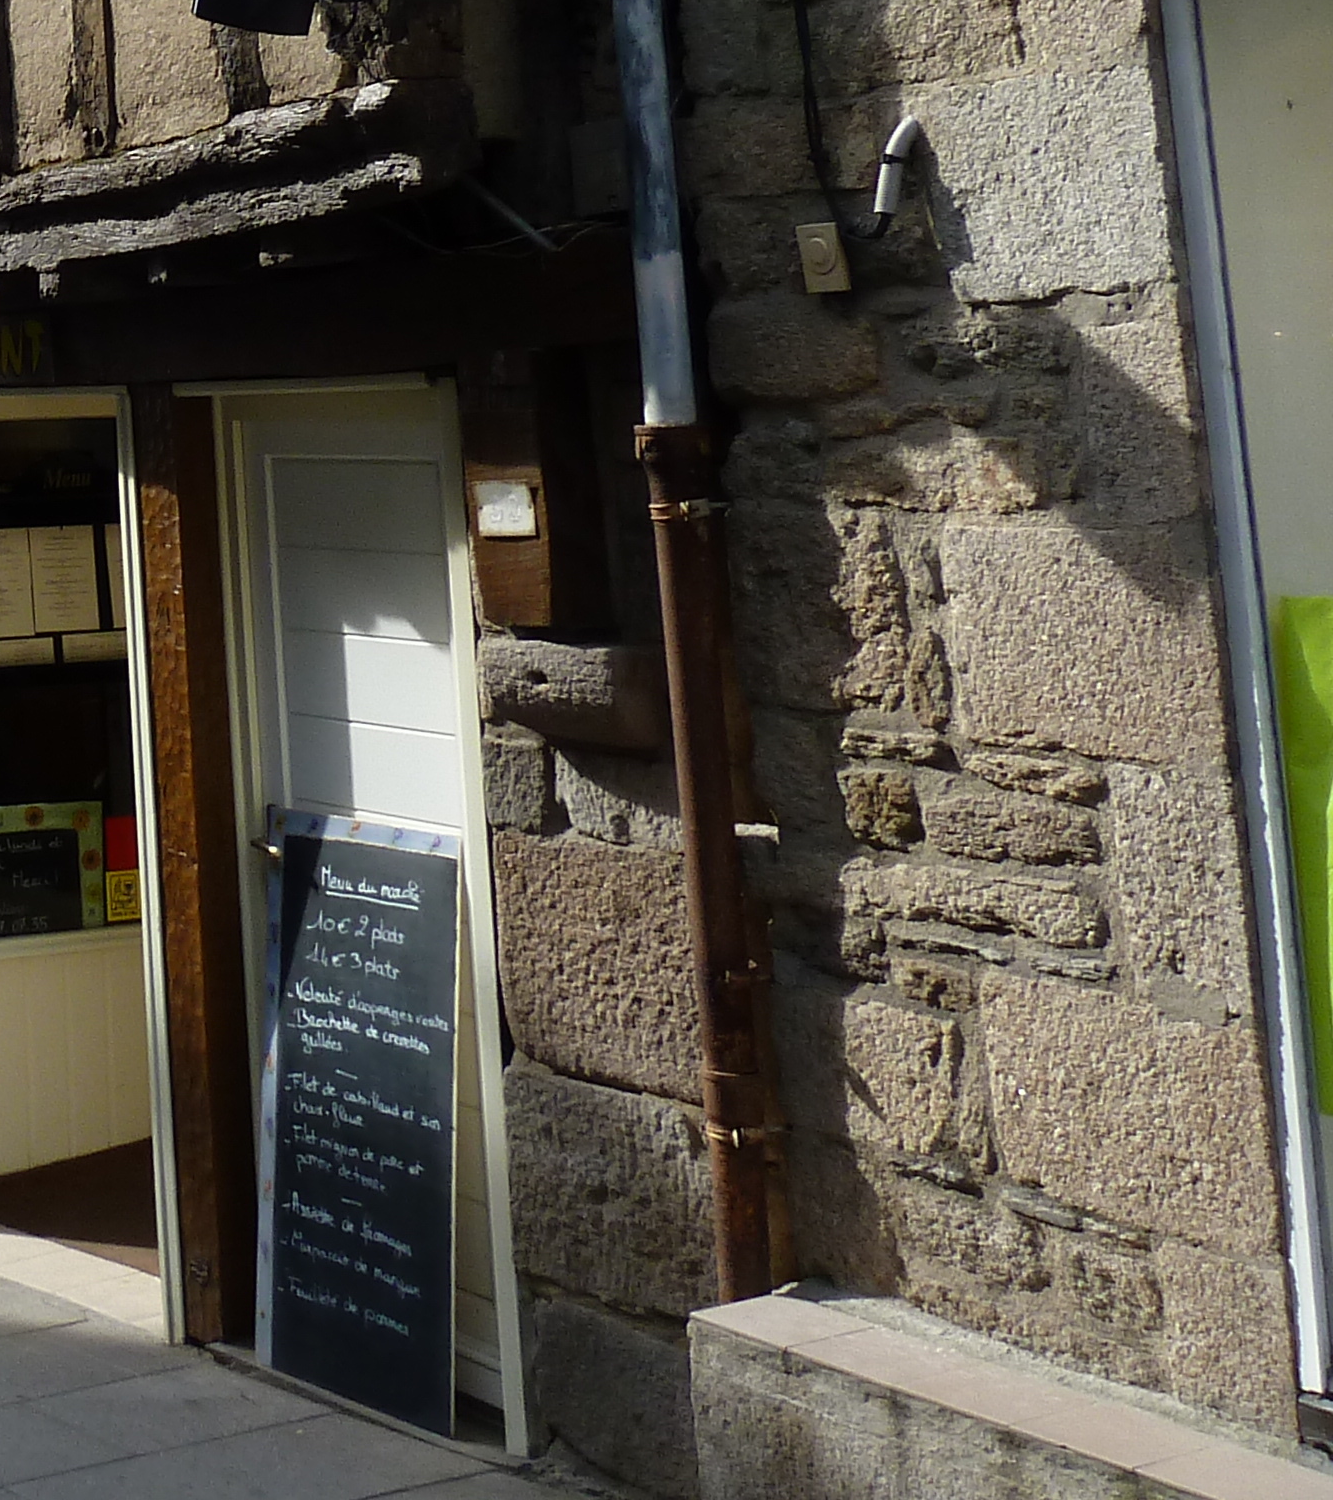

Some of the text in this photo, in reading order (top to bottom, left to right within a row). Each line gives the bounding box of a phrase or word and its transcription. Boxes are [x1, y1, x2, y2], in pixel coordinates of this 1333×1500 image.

[42, 468, 91, 490] Menu
[321, 864, 353, 891] Menu
[358, 877, 377, 894] du
[354, 915, 369, 937] 2
[372, 918, 406, 949] plats
[350, 952, 363, 969] 3
[365, 956, 401, 980] plats
[365, 1024, 379, 1039] de
[321, 1081, 338, 1098] de
[361, 1147, 375, 1163] de
